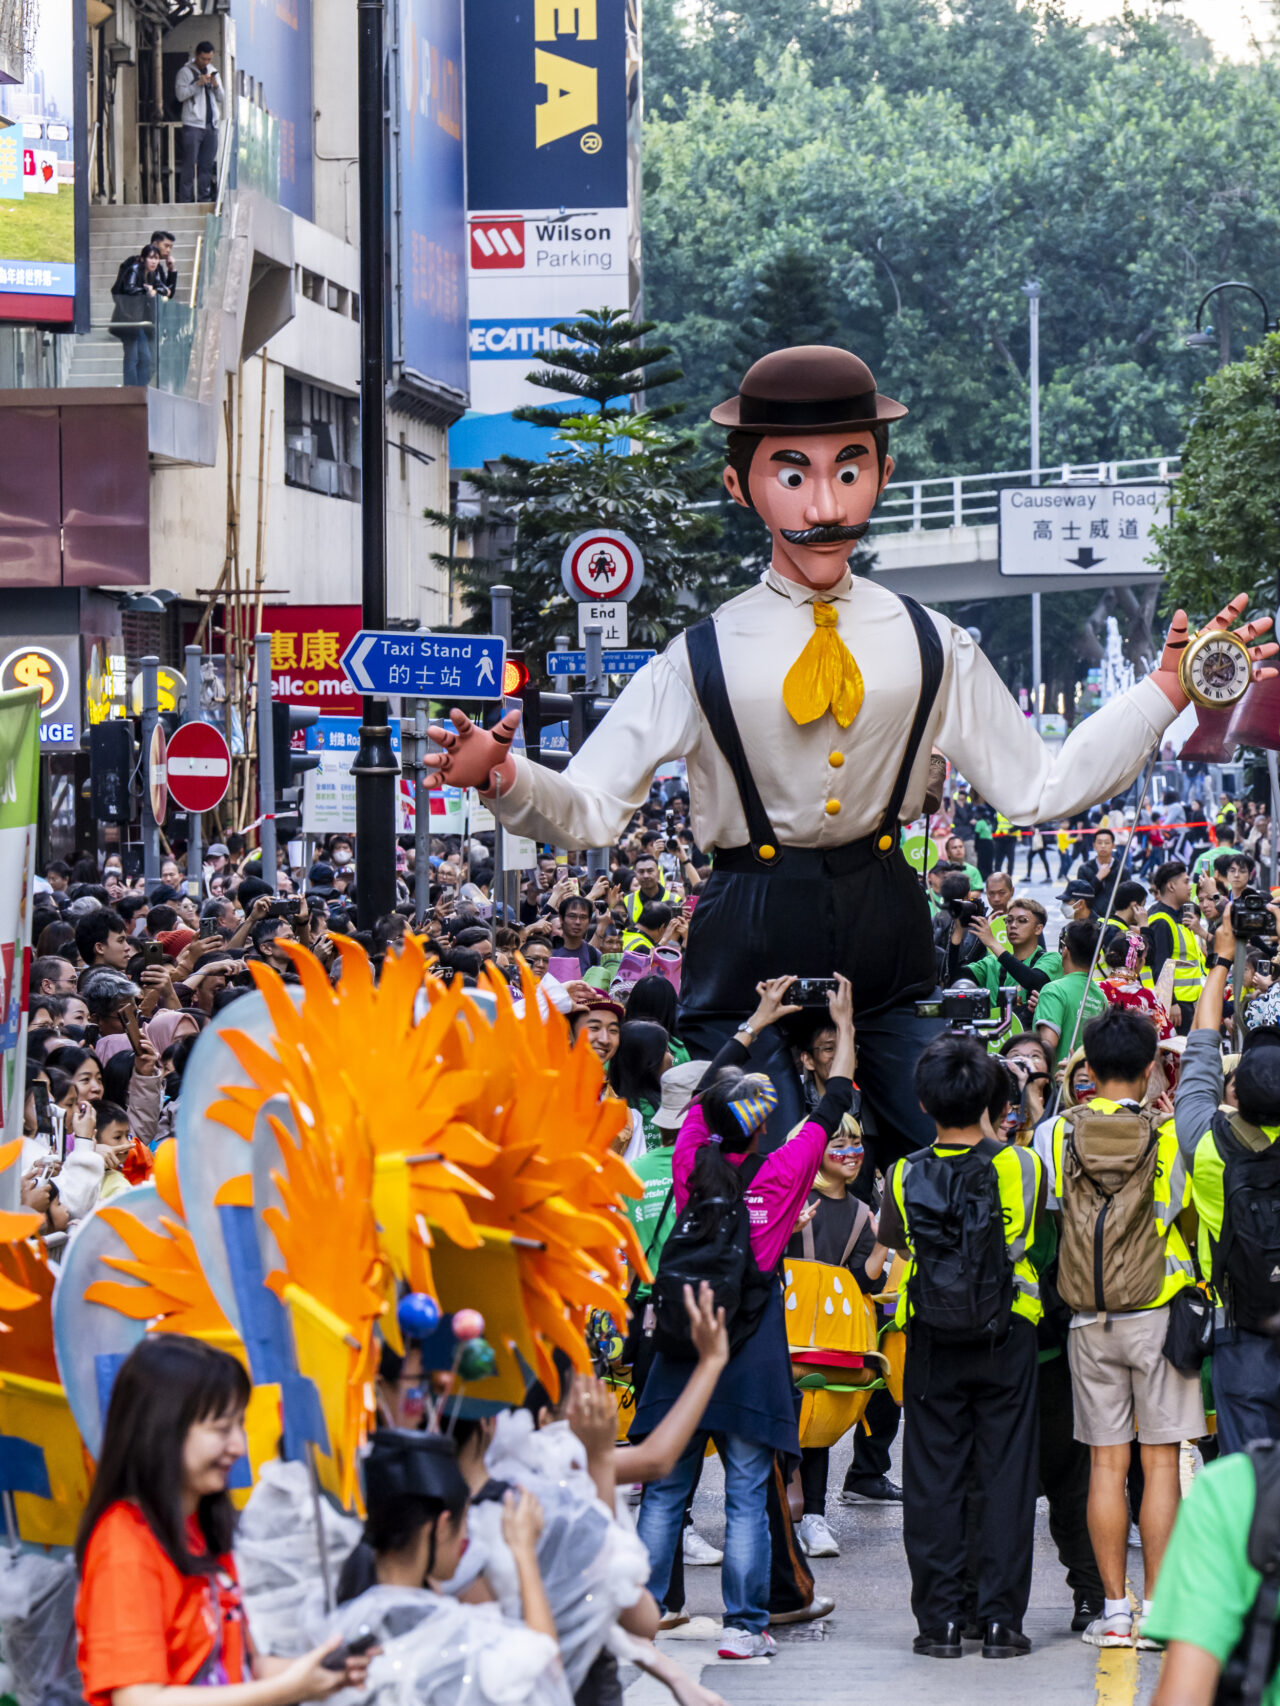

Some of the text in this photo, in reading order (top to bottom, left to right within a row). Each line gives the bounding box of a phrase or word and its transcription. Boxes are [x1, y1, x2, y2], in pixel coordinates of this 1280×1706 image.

[537, 225, 611, 241] Wilson
[537, 250, 612, 270] Parking
[469, 327, 591, 352] ECATHLO
[1010, 491, 1157, 508] Causeway Road
[1033, 519, 1139, 541] 高士威道
[590, 607, 616, 619] End
[270, 629, 340, 671] 惠康
[381, 641, 473, 659] Taxi Stand
[389, 664, 462, 688] 的士站
[347, 733, 361, 747] Roa
[910, 848, 931, 860] GO
